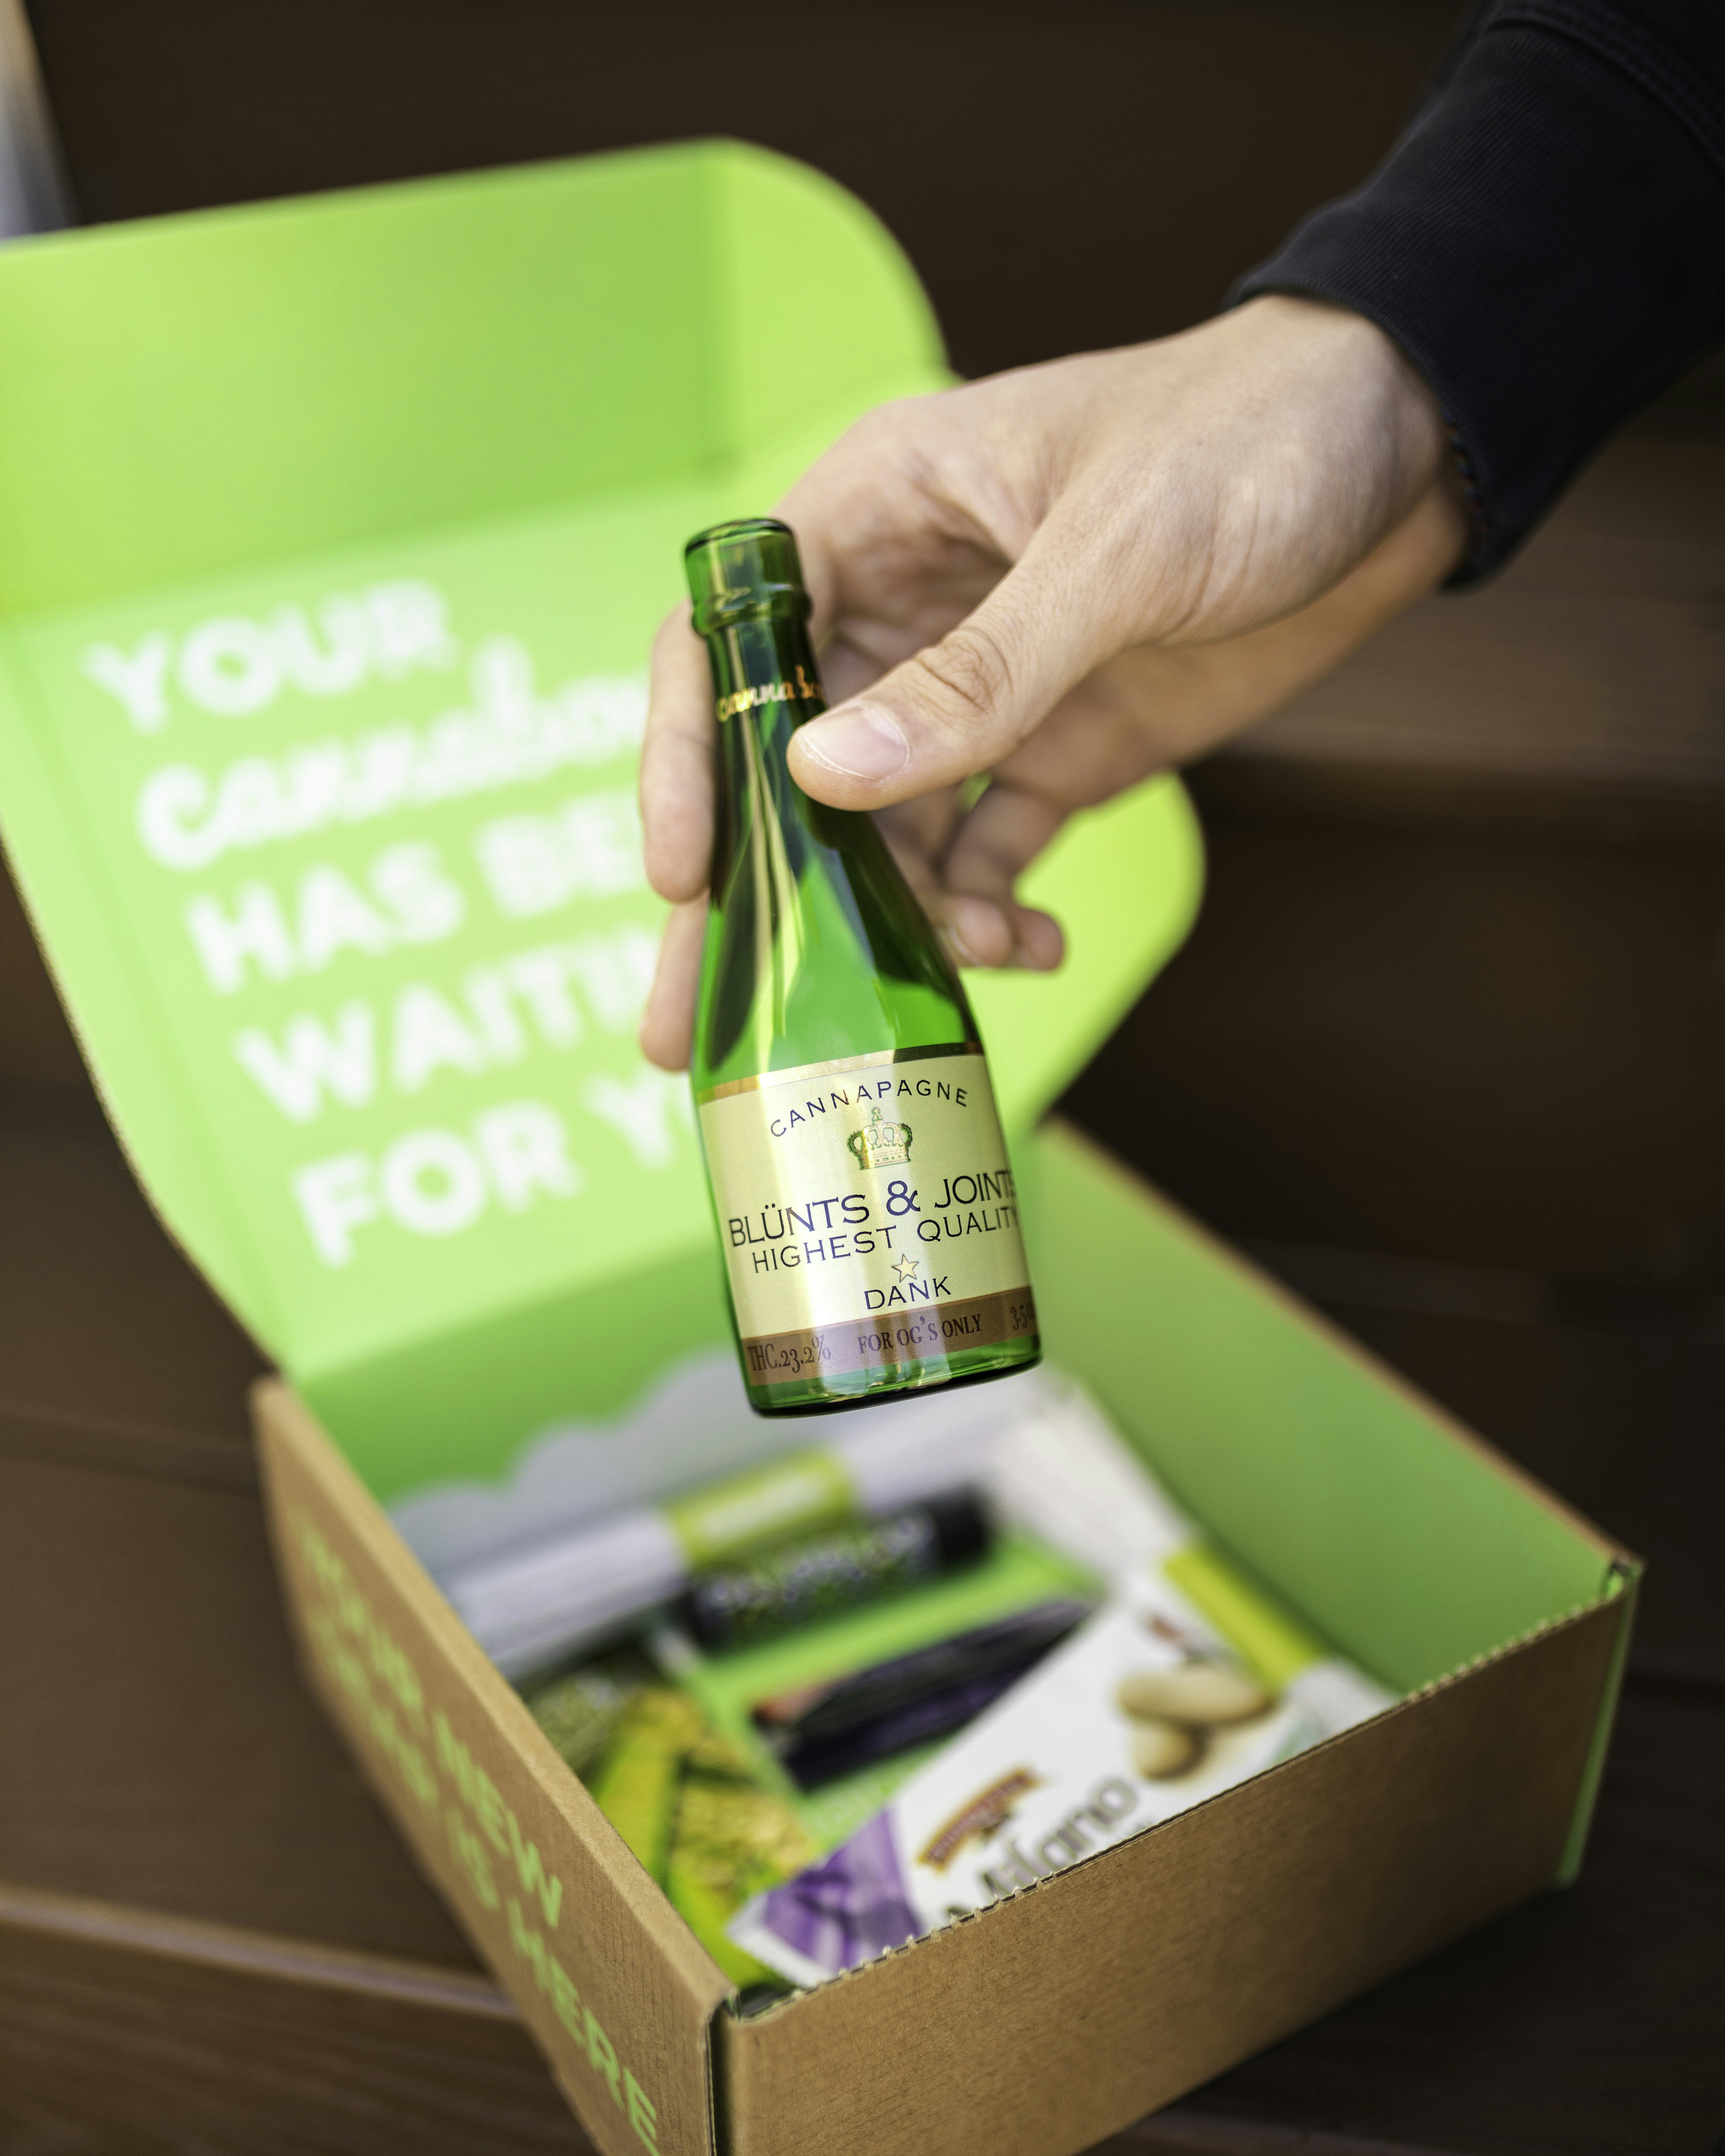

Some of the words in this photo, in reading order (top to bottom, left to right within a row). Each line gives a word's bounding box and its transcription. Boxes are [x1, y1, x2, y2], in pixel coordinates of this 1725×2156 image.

[83, 584, 452, 732] YOUR
[187, 843, 463, 993] HAS
[770, 1079, 968, 1138] CANNAPAGNE
[295, 1100, 581, 1267] FOR
[729, 1194, 870, 1247] BLÜNTS
[886, 1180, 920, 1217] &
[752, 1225, 897, 1274] HIGHEST
[864, 1276, 952, 1310] DANK
[858, 1331, 894, 1354] FOR
[941, 1313, 982, 1339] ONLY
[432, 1707, 563, 1930] NEW
[506, 1896, 659, 2156] HERE
